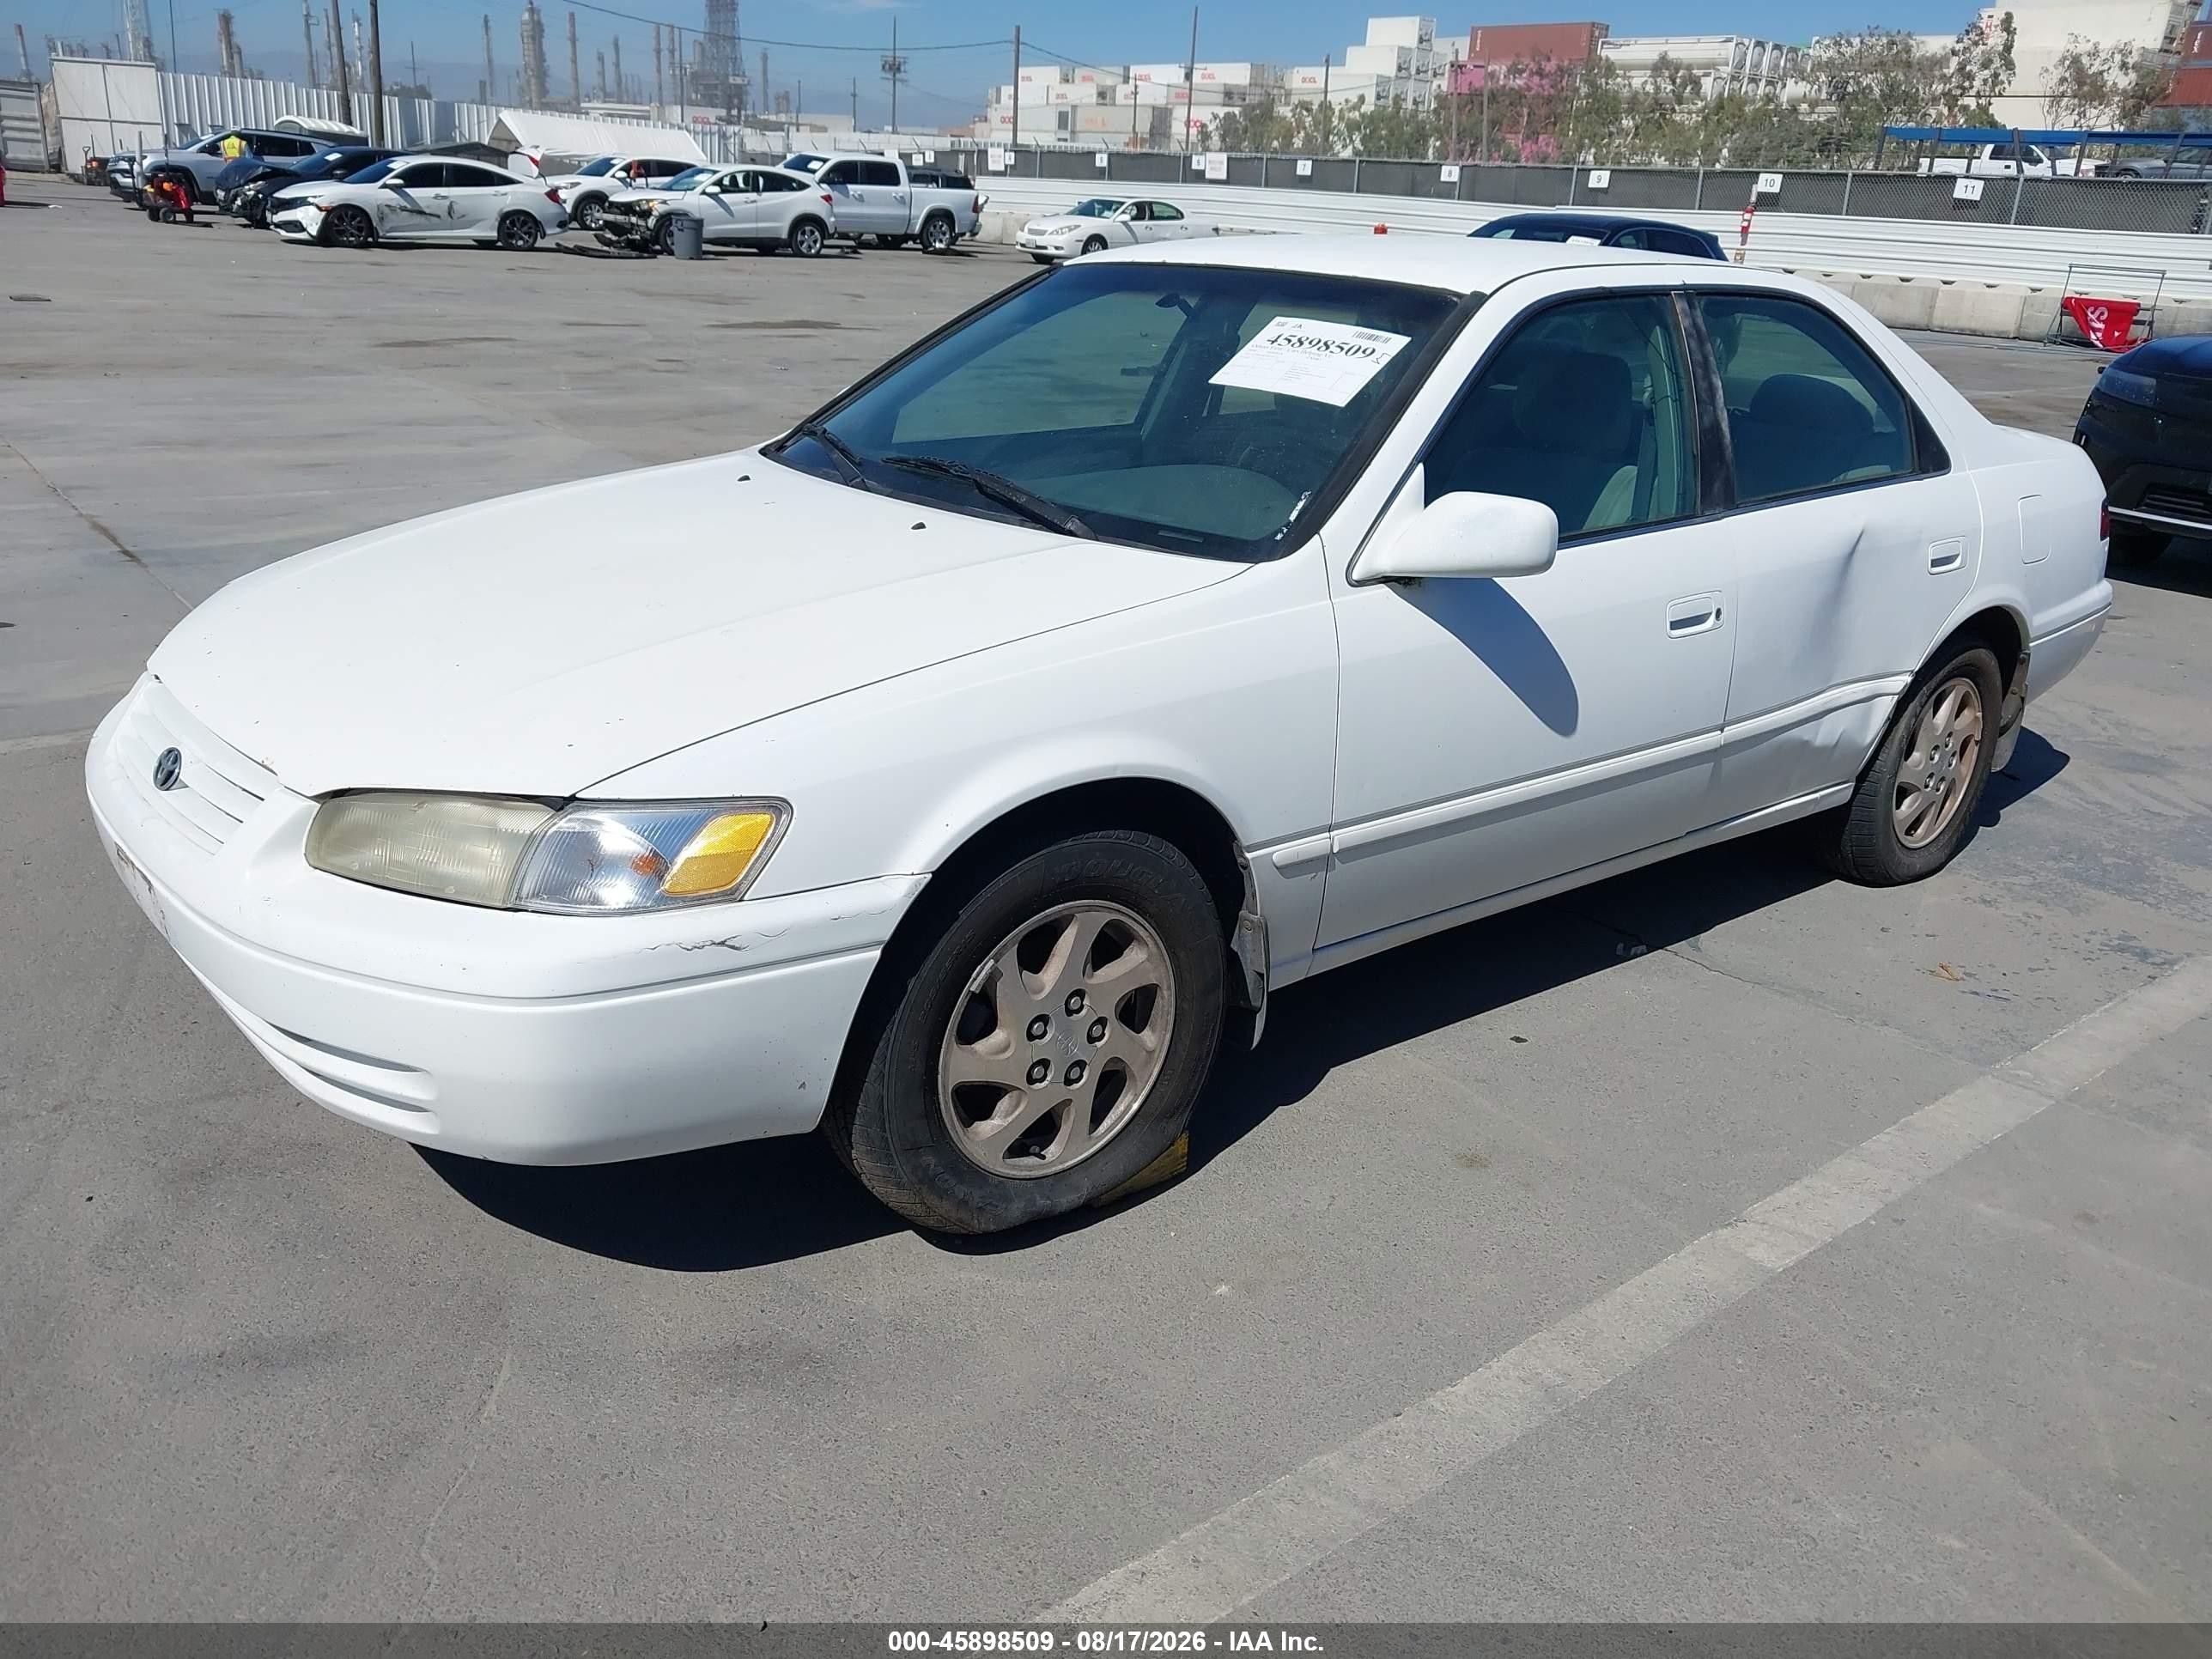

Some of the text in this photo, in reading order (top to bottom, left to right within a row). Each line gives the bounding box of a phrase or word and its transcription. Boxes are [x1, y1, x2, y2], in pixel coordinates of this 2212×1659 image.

[1447, 169, 1453, 178] 8
[1595, 174, 1602, 185] 9
[1764, 178, 1776, 188] 10
[1963, 184, 1976, 195] 11
[1267, 332, 1376, 359] 45898509
